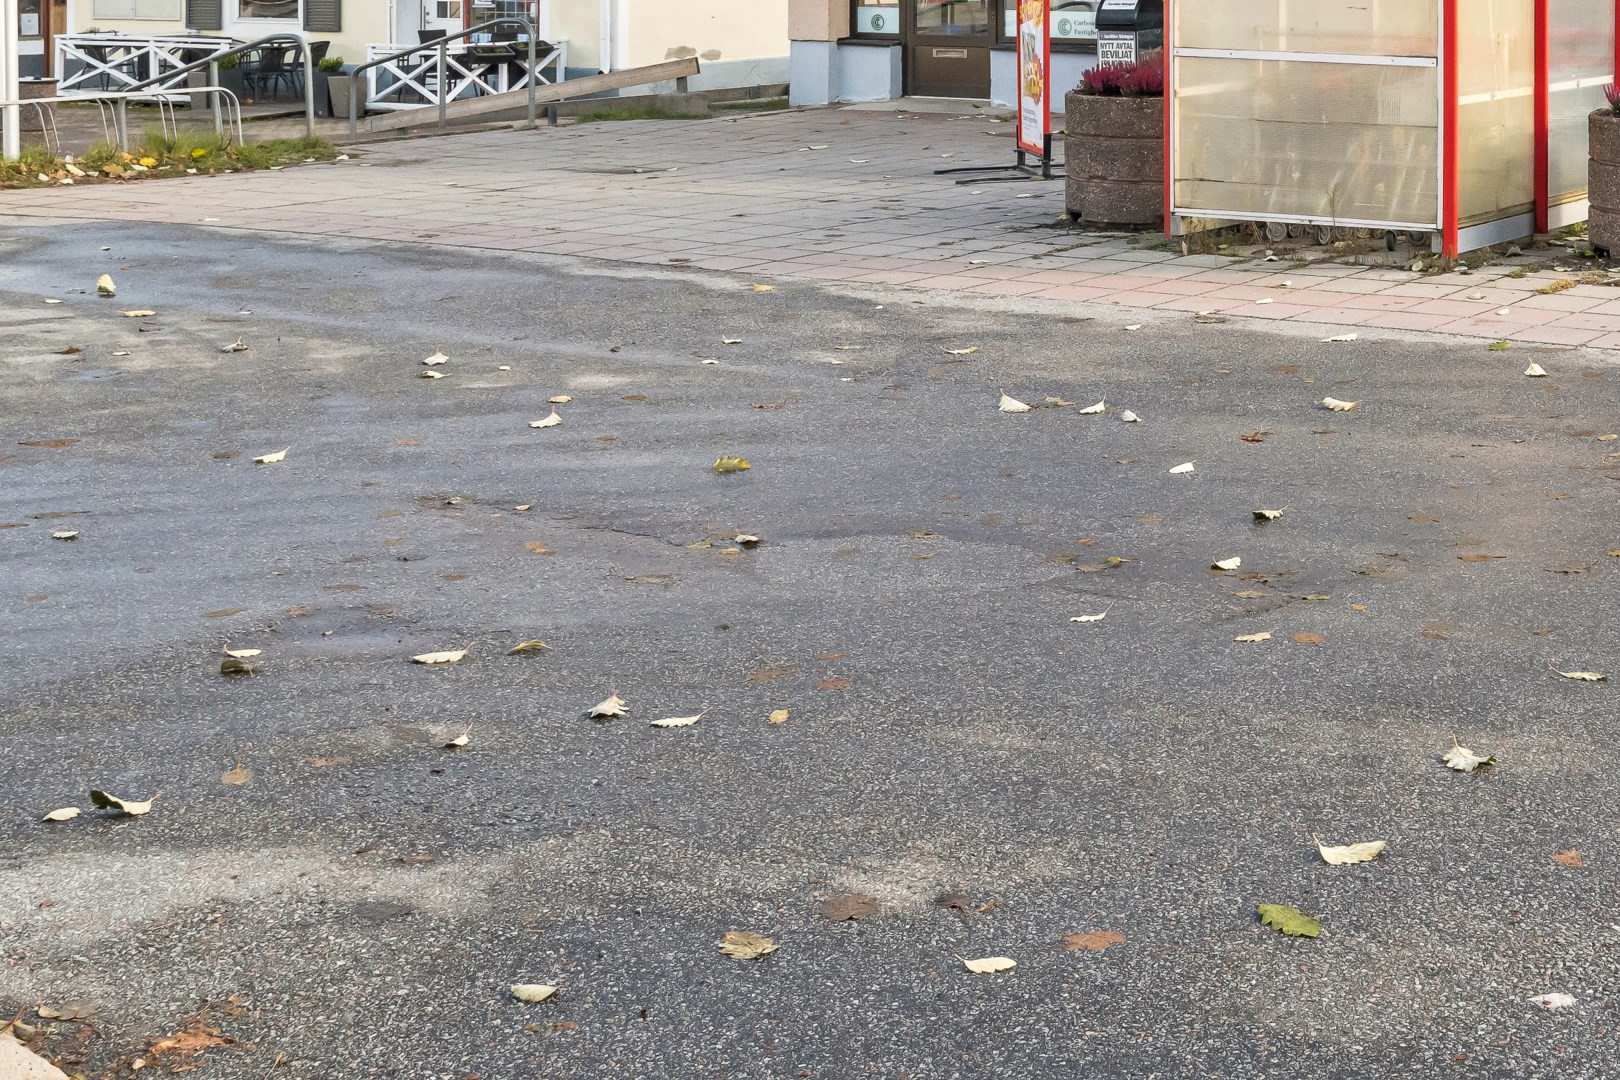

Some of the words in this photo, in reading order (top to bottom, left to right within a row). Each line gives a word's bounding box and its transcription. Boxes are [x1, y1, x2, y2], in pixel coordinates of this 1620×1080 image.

[1100, 42, 1115, 50] NYTT
[1116, 42, 1133, 50] AVTAL
[1101, 50, 1133, 60] BEVILJAT
